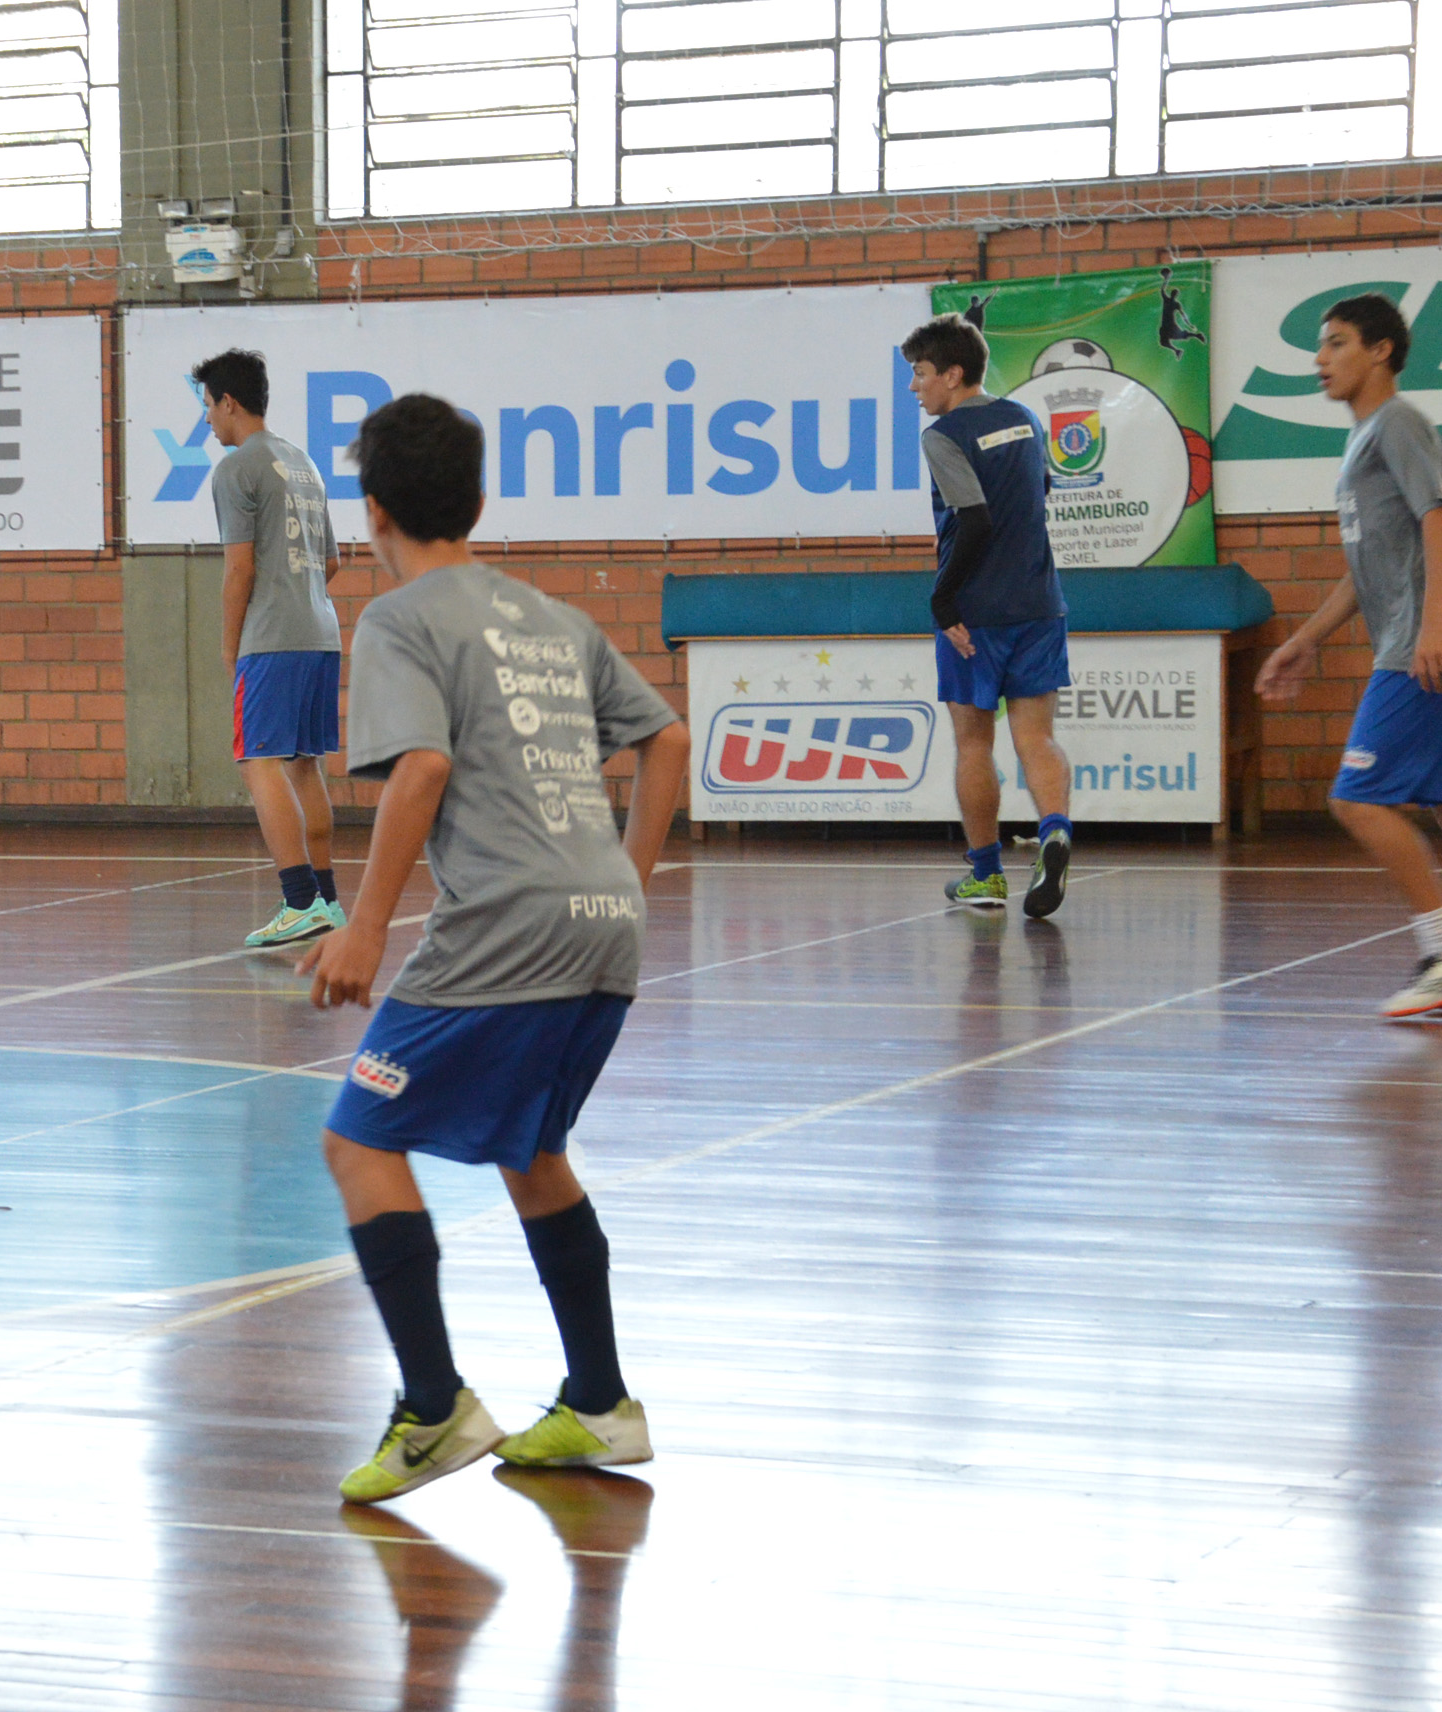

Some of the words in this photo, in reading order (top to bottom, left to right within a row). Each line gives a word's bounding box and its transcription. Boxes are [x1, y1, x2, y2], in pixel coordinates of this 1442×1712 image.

[1106, 488, 1124, 500] DE
[1054, 500, 1150, 522] HAMBURGO
[1082, 521, 1145, 537] Municipal
[1050, 540, 1090, 553] sporte
[1092, 540, 1101, 550] e
[1104, 537, 1139, 549] Lazer
[1062, 552, 1100, 565] SMEL
[1054, 689, 1197, 719] EEVALE
[718, 716, 915, 783] UJR
[709, 799, 750, 815] UNIÃO
[751, 801, 796, 815] JOVEM
[799, 801, 819, 815] DO
[822, 799, 872, 816] RINCÃO
[884, 801, 914, 813] 1978
[569, 894, 639, 920] FUTSAL
